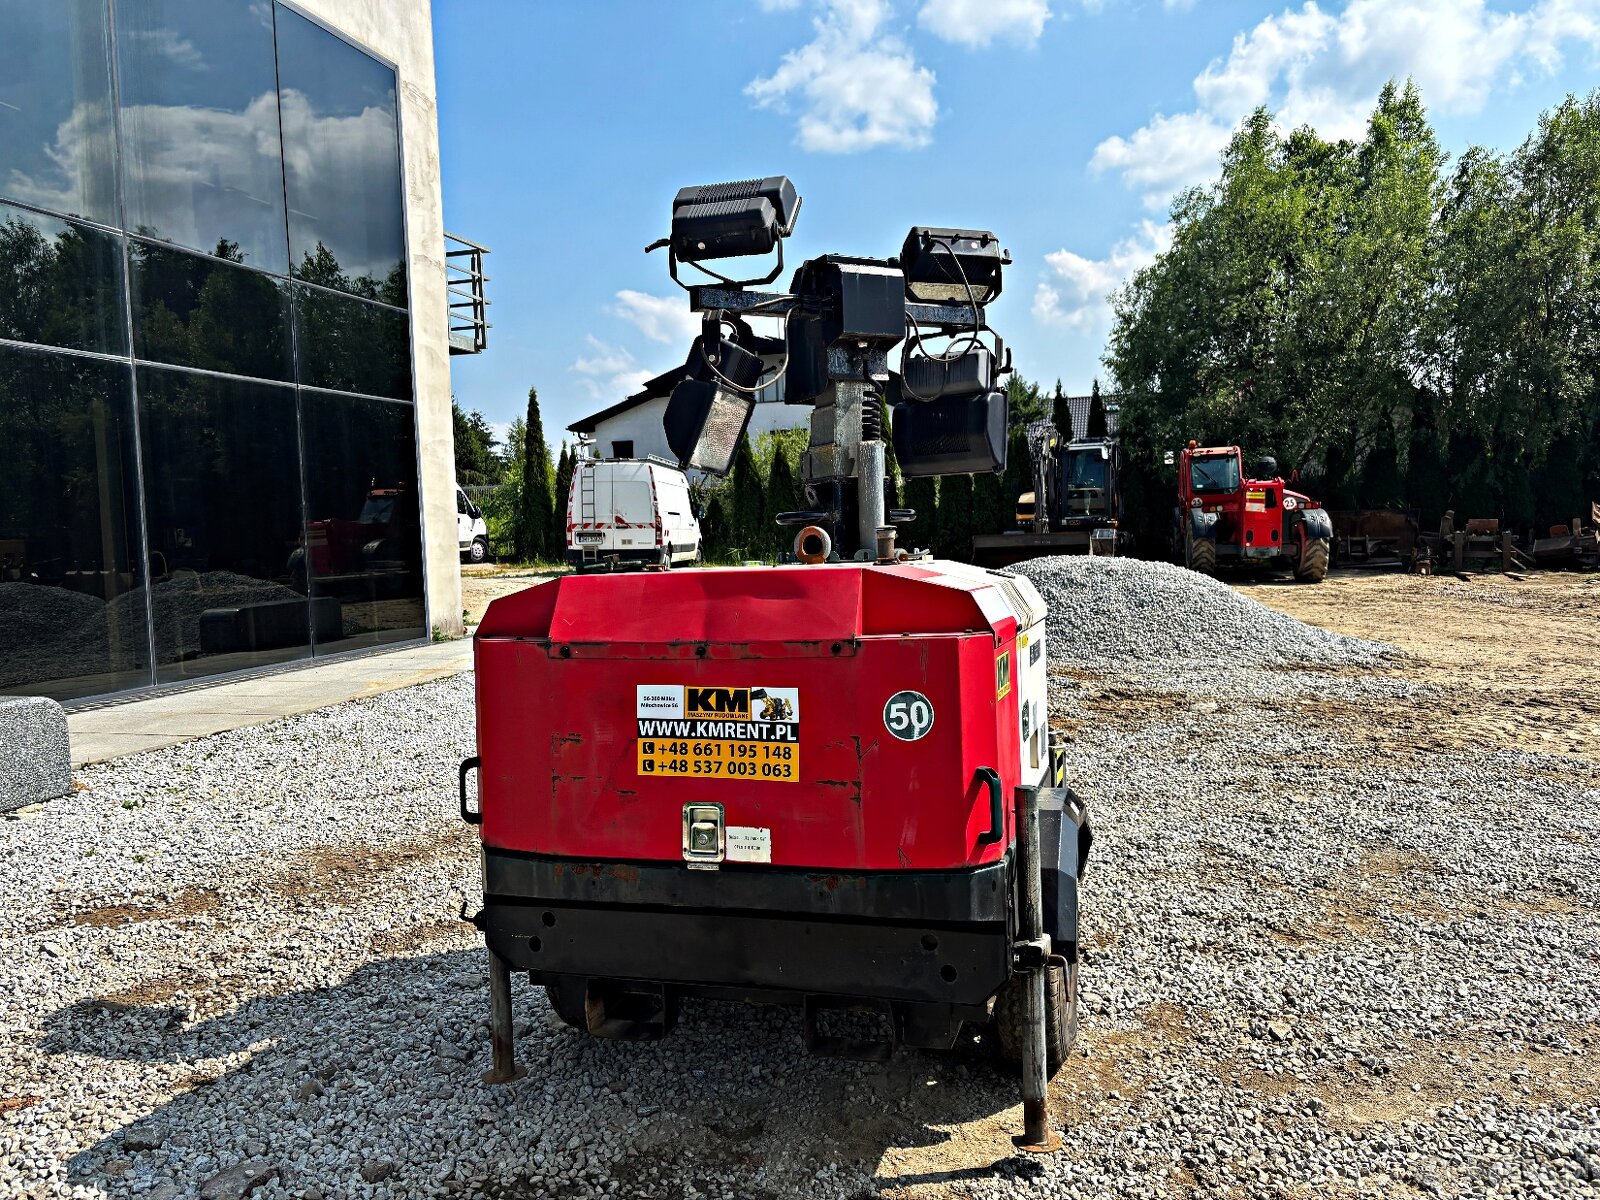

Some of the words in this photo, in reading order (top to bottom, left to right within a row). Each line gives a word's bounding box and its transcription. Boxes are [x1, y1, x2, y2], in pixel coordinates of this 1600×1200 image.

[1284, 499, 1295, 508] 25
[687, 688, 749, 713] KM
[889, 700, 929, 731] 50
[638, 720, 797, 741] WWW.KMRENT.PL
[658, 742, 689, 756] +48
[692, 742, 722, 757] 661
[728, 743, 757, 759] 195
[763, 745, 792, 760] 148
[658, 759, 689, 773] +48
[692, 760, 723, 774] 537
[727, 761, 757, 776] 003
[761, 762, 792, 778] 063
